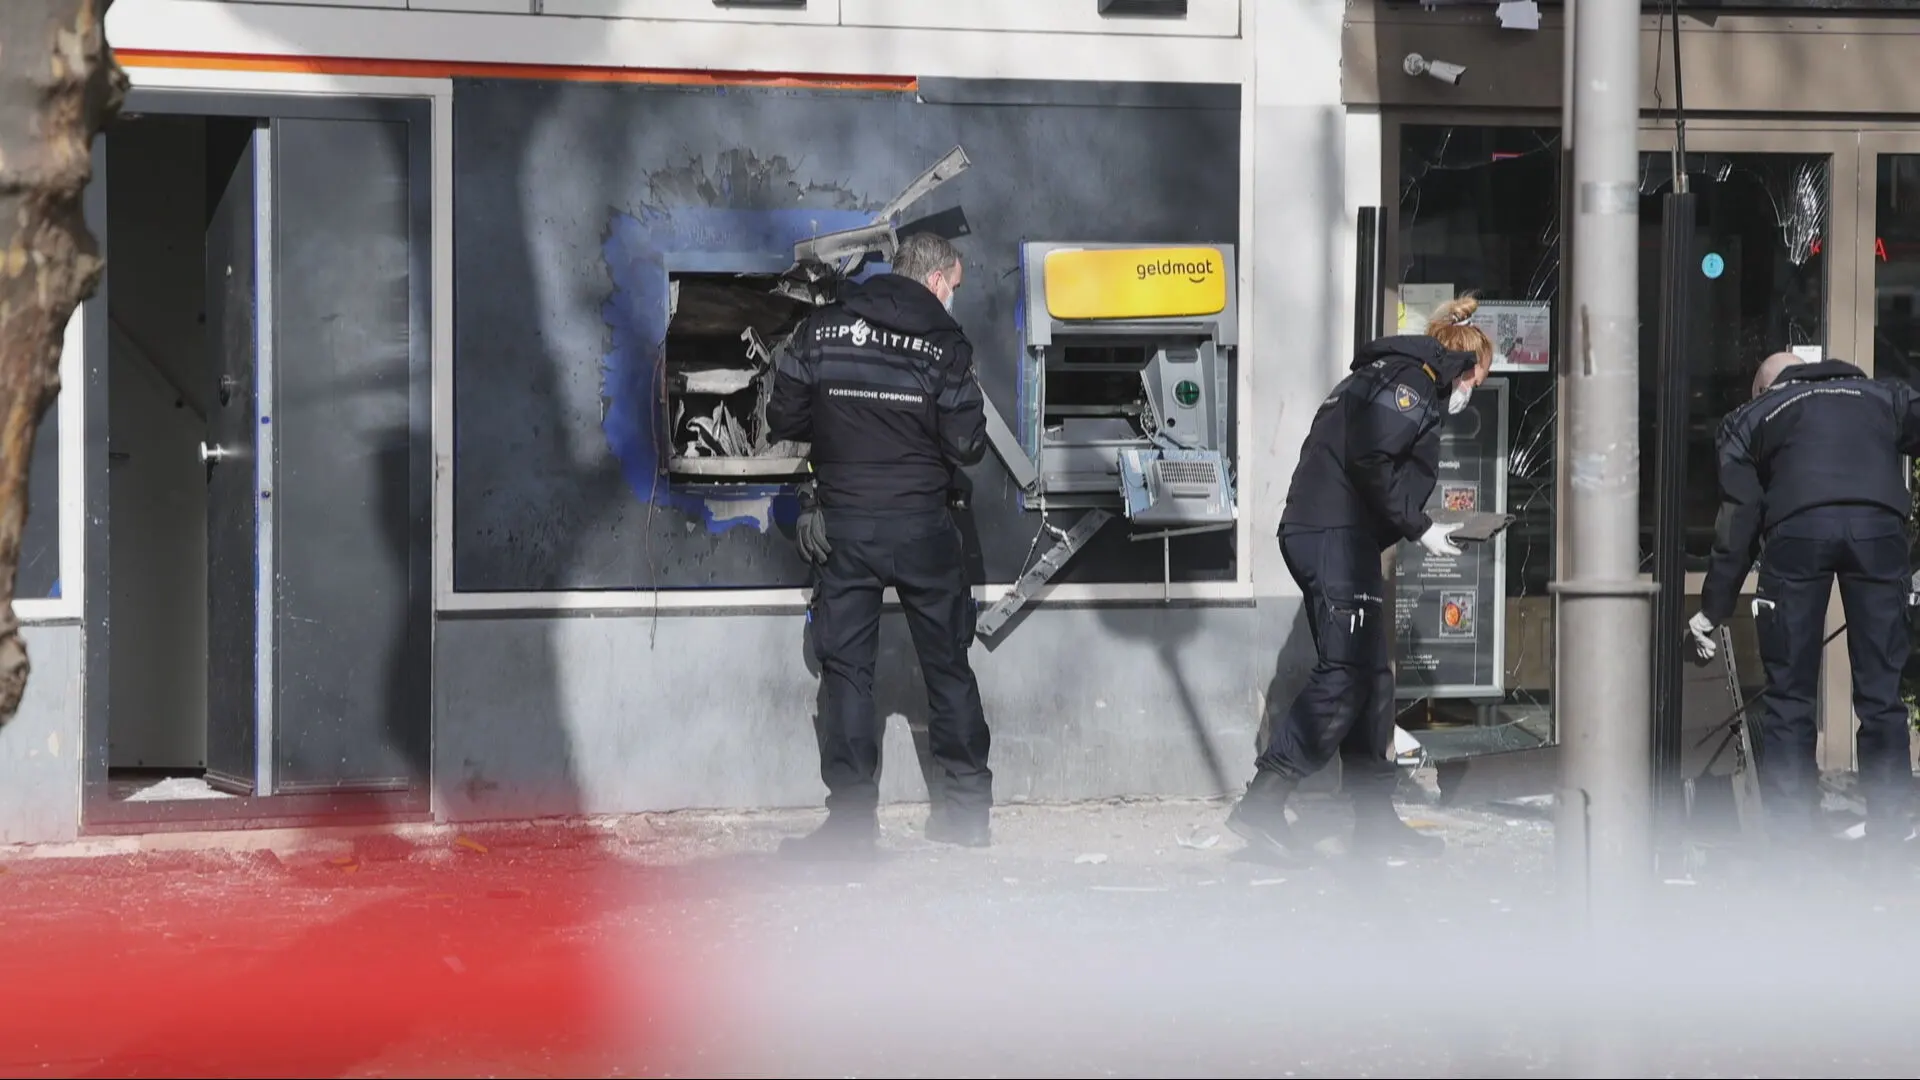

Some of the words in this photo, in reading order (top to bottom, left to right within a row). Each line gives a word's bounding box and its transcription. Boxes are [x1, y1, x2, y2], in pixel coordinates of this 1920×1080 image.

[1136, 259, 1213, 280] geldmaat
[838, 319, 924, 350] POLITIE
[829, 388, 878, 399] FORENSISCHE
[879, 392, 923, 403] OPSPORING
